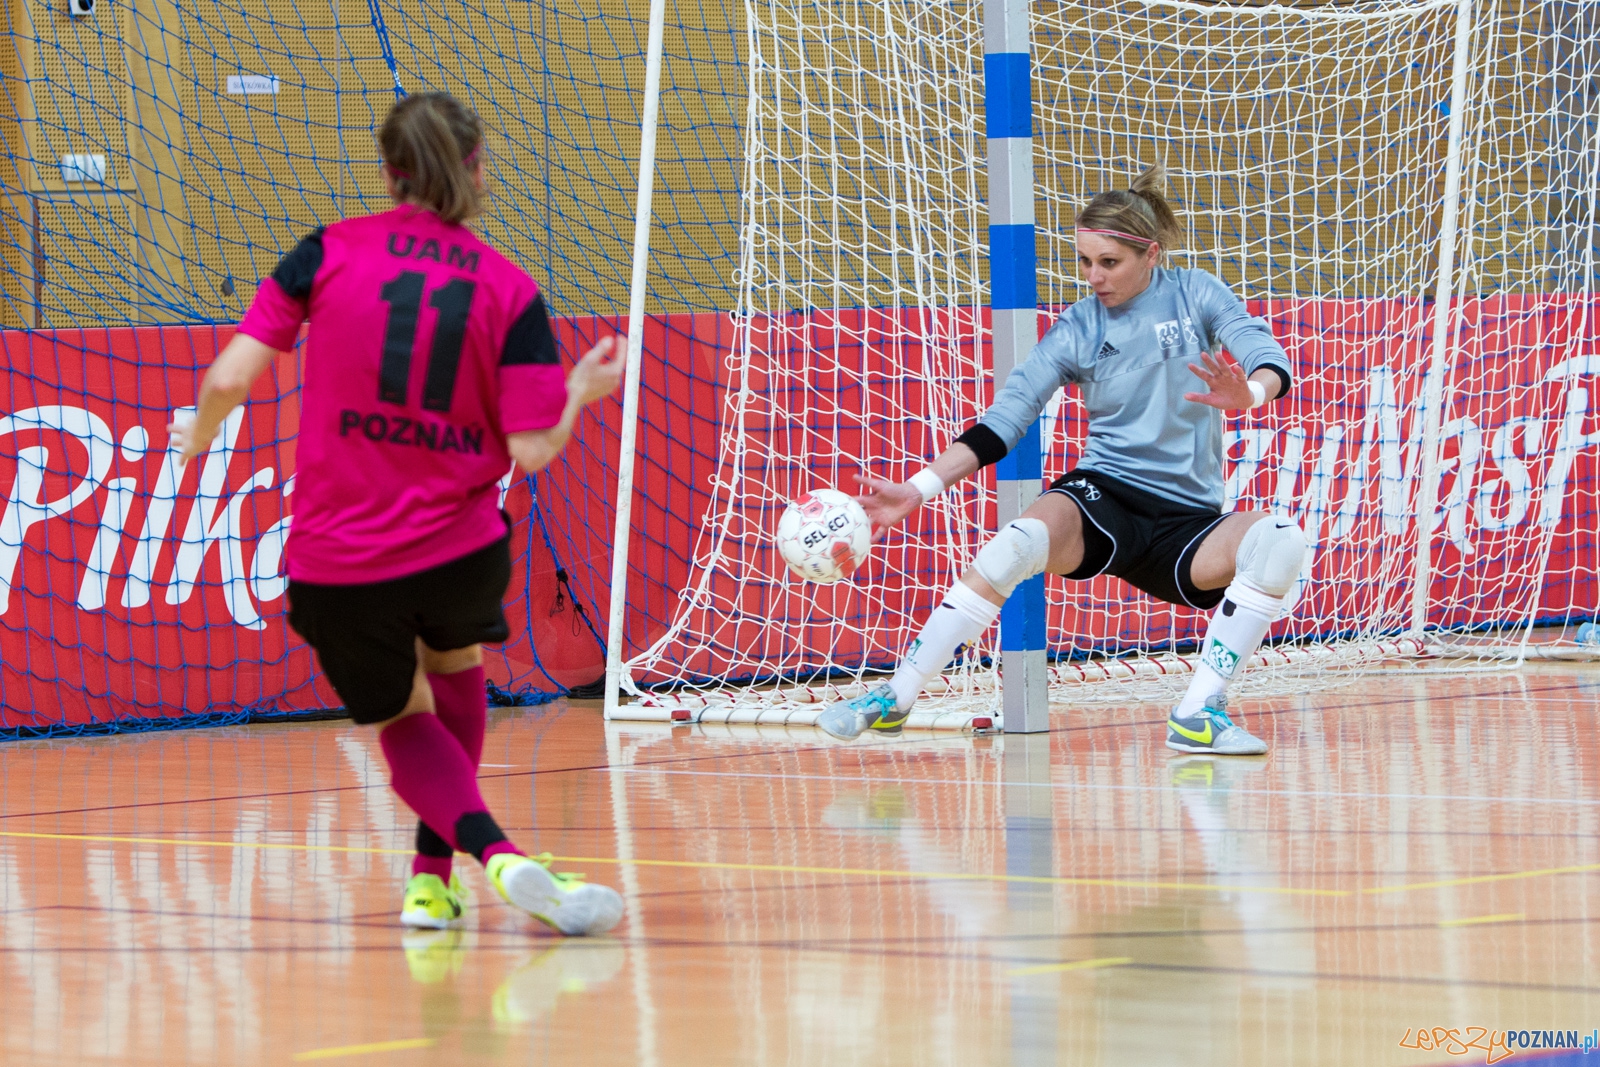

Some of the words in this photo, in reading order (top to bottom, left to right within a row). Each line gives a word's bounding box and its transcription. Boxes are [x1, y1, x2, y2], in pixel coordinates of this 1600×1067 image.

[387, 232, 481, 273] UAM
[377, 269, 477, 413] 11
[1097, 348, 1121, 361] adidas
[804, 512, 850, 549] SELECT
